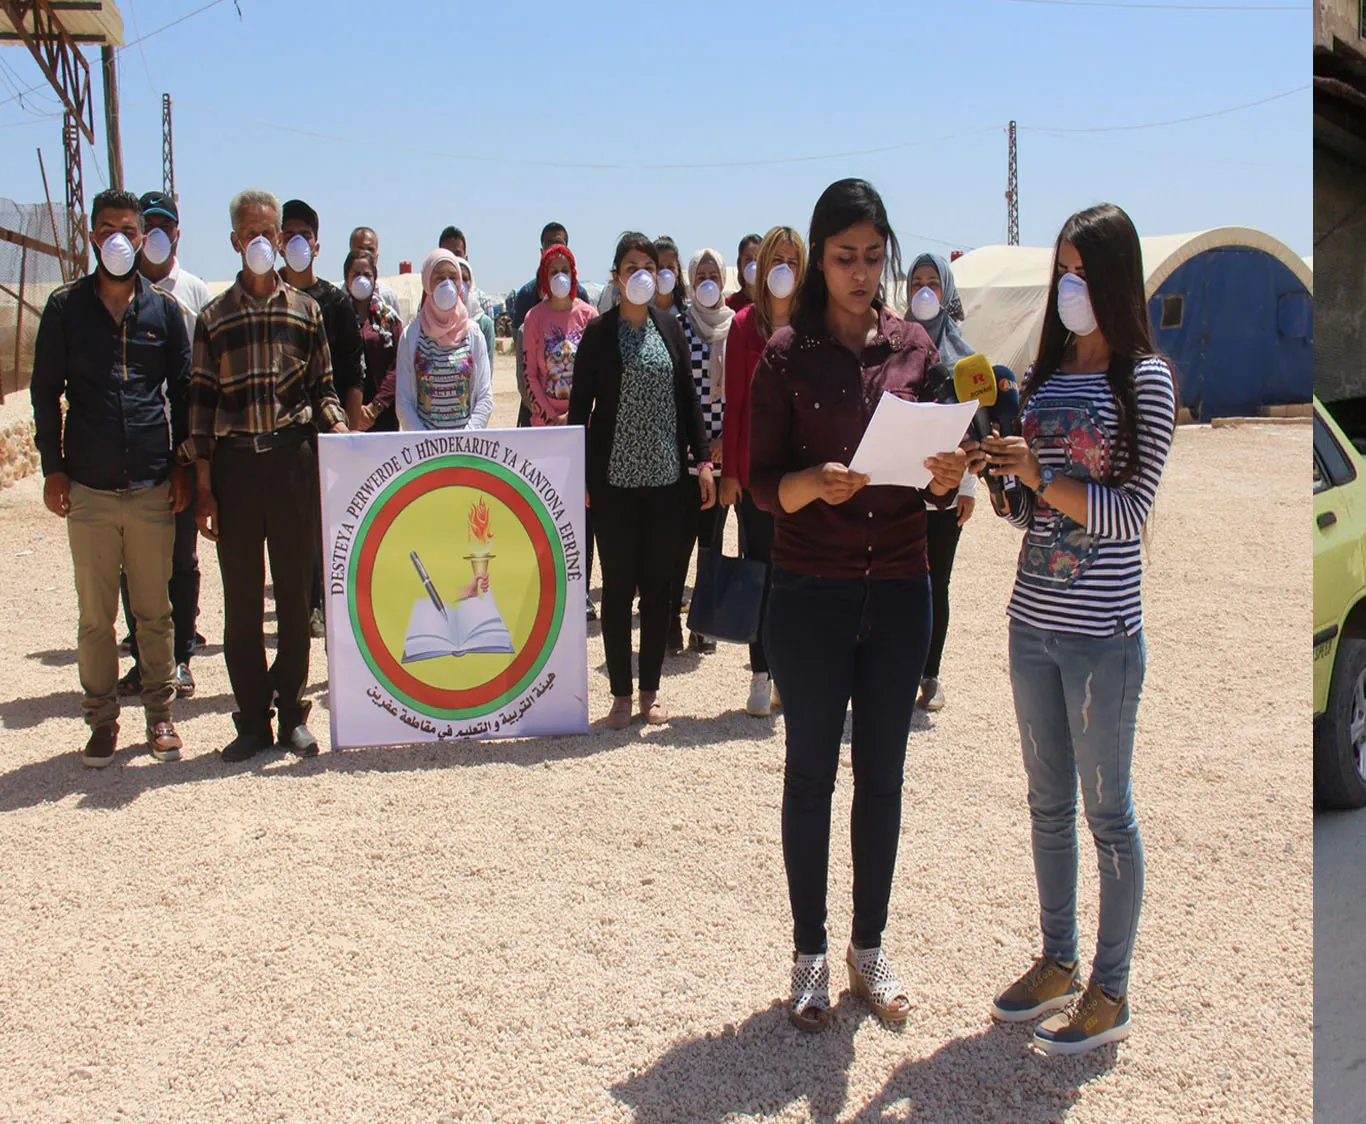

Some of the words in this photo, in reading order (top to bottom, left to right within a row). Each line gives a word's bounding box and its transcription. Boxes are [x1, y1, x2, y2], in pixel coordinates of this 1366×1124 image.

[331, 522, 355, 596] DESTEYA
[346, 456, 402, 520] PERWERDE
[402, 447, 413, 465] Û
[415, 436, 500, 460] HÎNDEKARIYÊ
[502, 447, 518, 469] YA
[519, 459, 566, 522] KANTONA
[559, 521, 582, 582] EFRÎNÊ
[366, 685, 399, 718] عفرين
[498, 694, 536, 727] التربية
[399, 708, 437, 734] مقاطعة
[437, 724, 453, 742] في
[455, 720, 492, 741] التعليم
